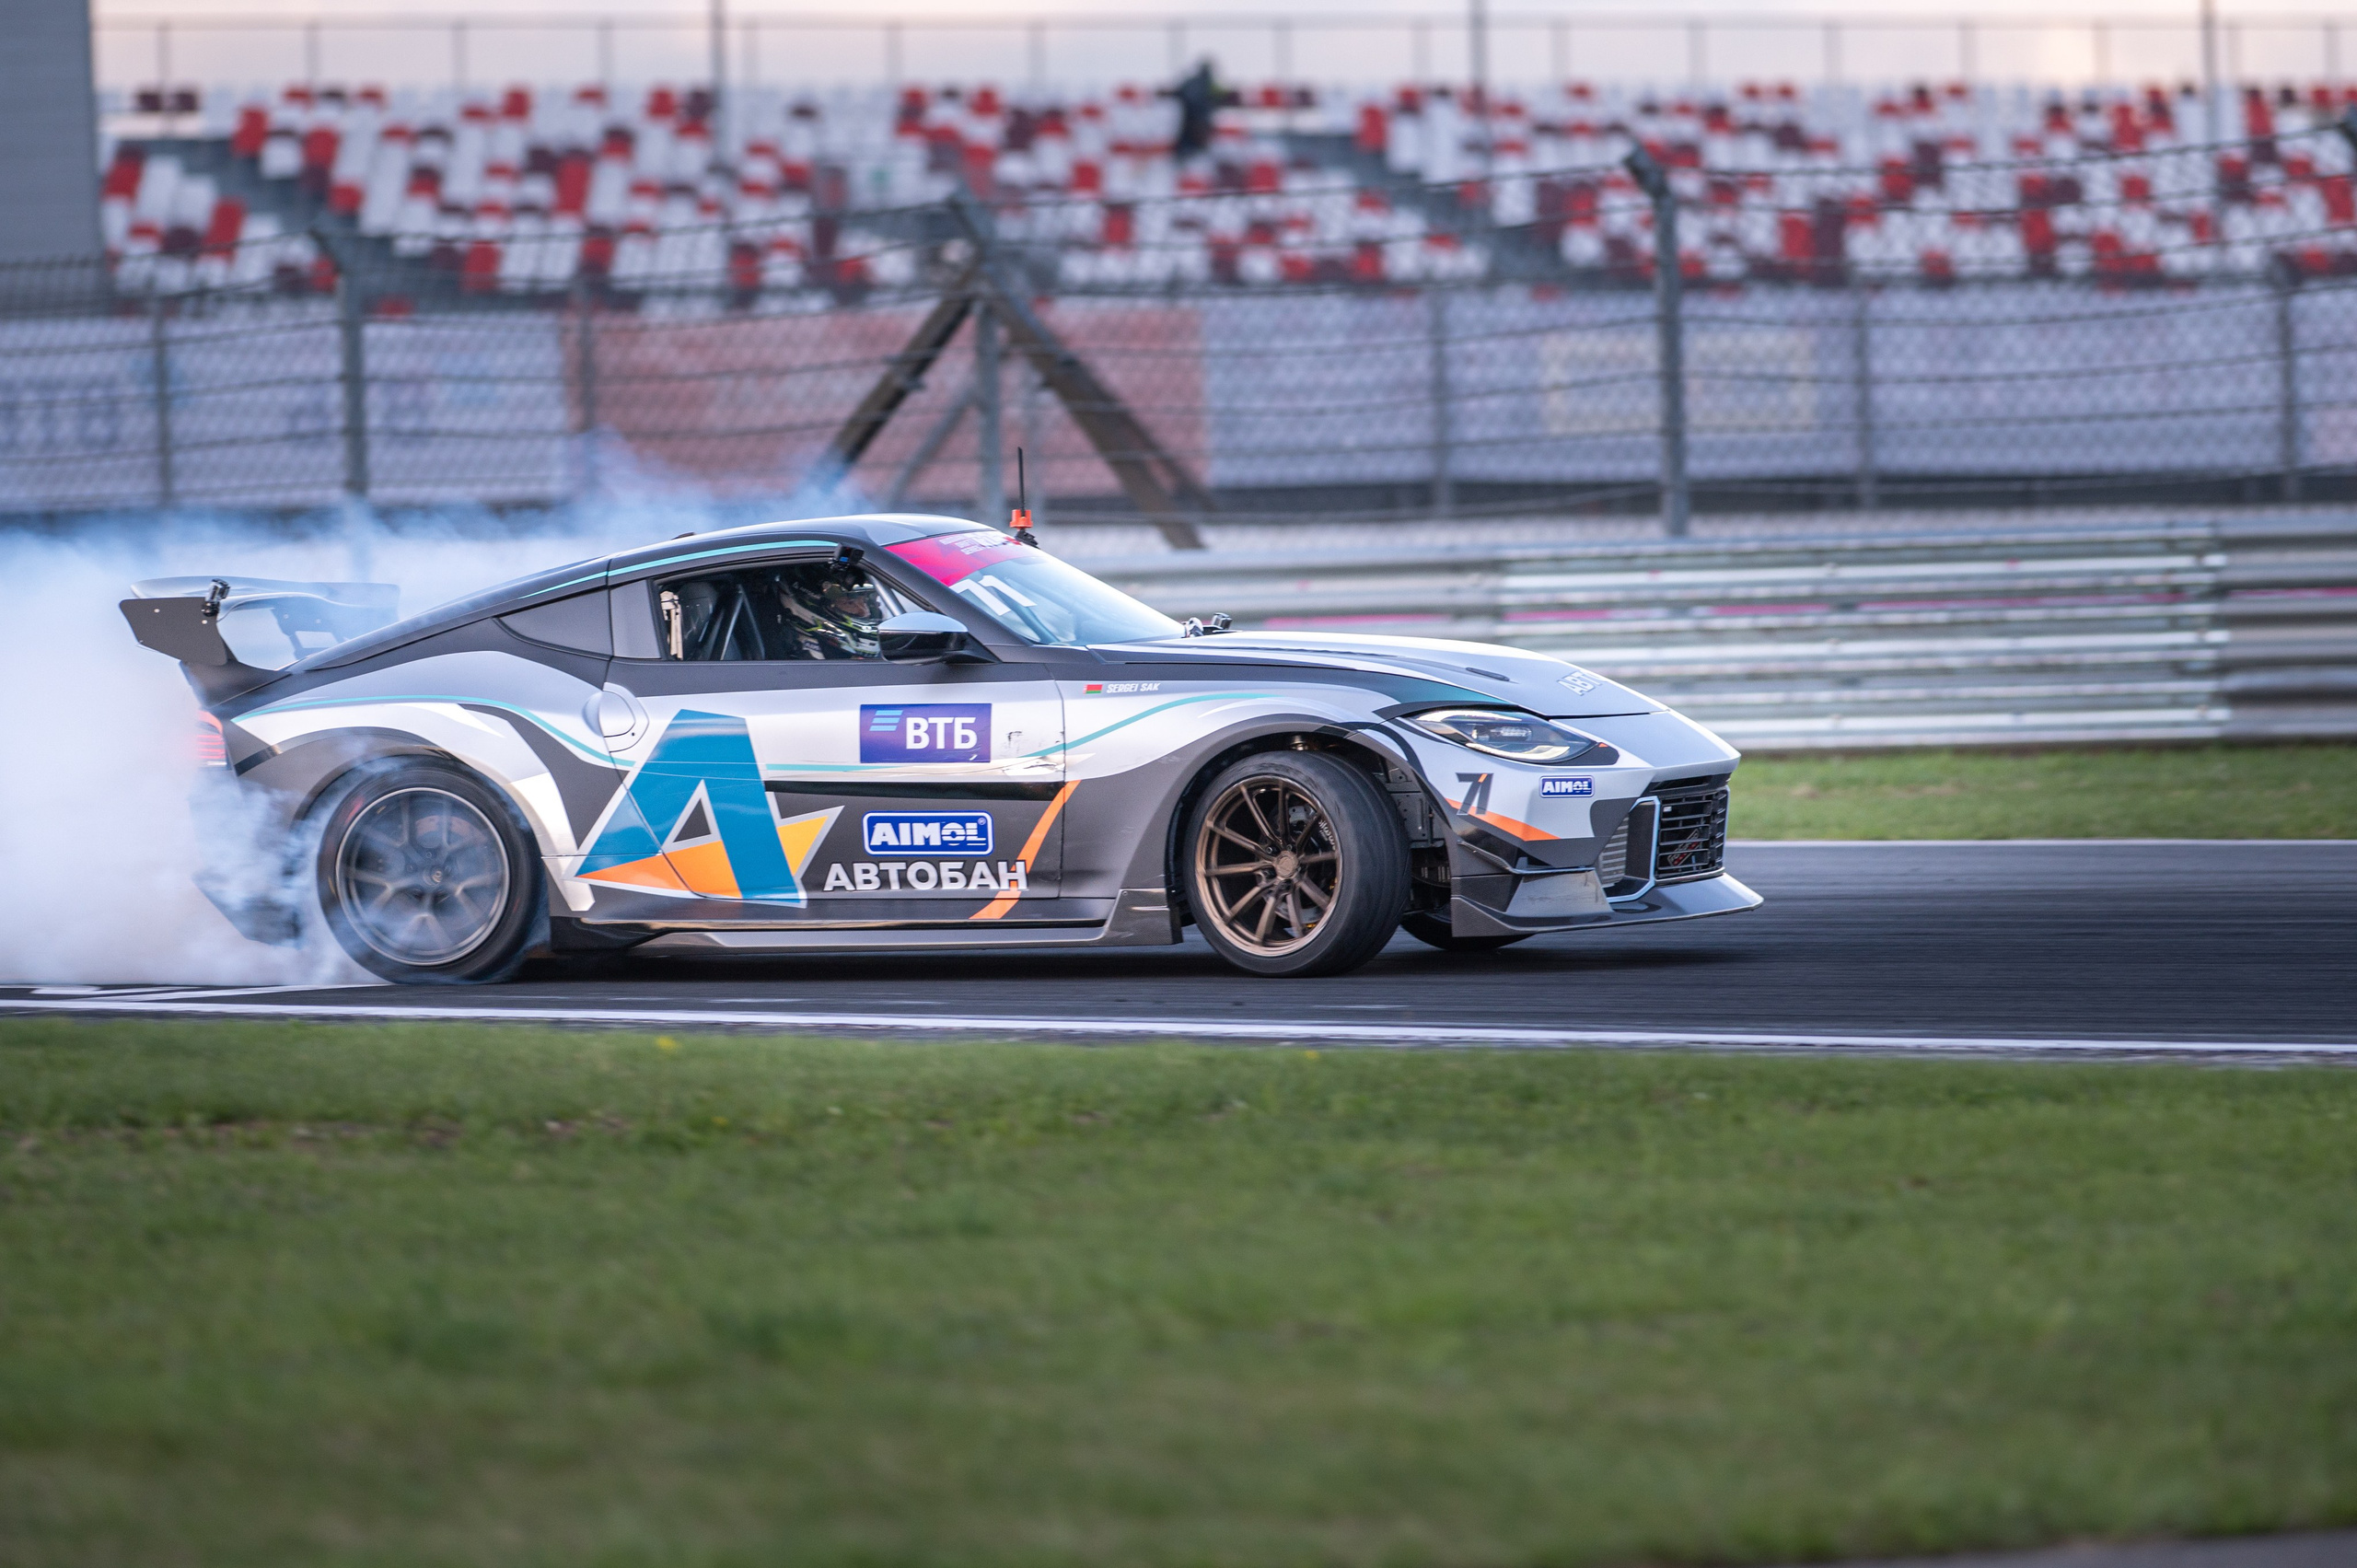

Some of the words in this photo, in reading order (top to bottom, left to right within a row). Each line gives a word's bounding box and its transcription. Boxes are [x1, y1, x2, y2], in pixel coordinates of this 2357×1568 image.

[948, 575, 1037, 616] 71
[1107, 683, 1139, 694] SERGEI
[1140, 682, 1161, 691] SAK
[905, 716, 978, 749] ВТБ
[1456, 772, 1494, 816] 71
[1542, 781, 1592, 794] AIMOL
[870, 822, 987, 846] AIMOL
[823, 860, 1028, 891] АВТОБАН
